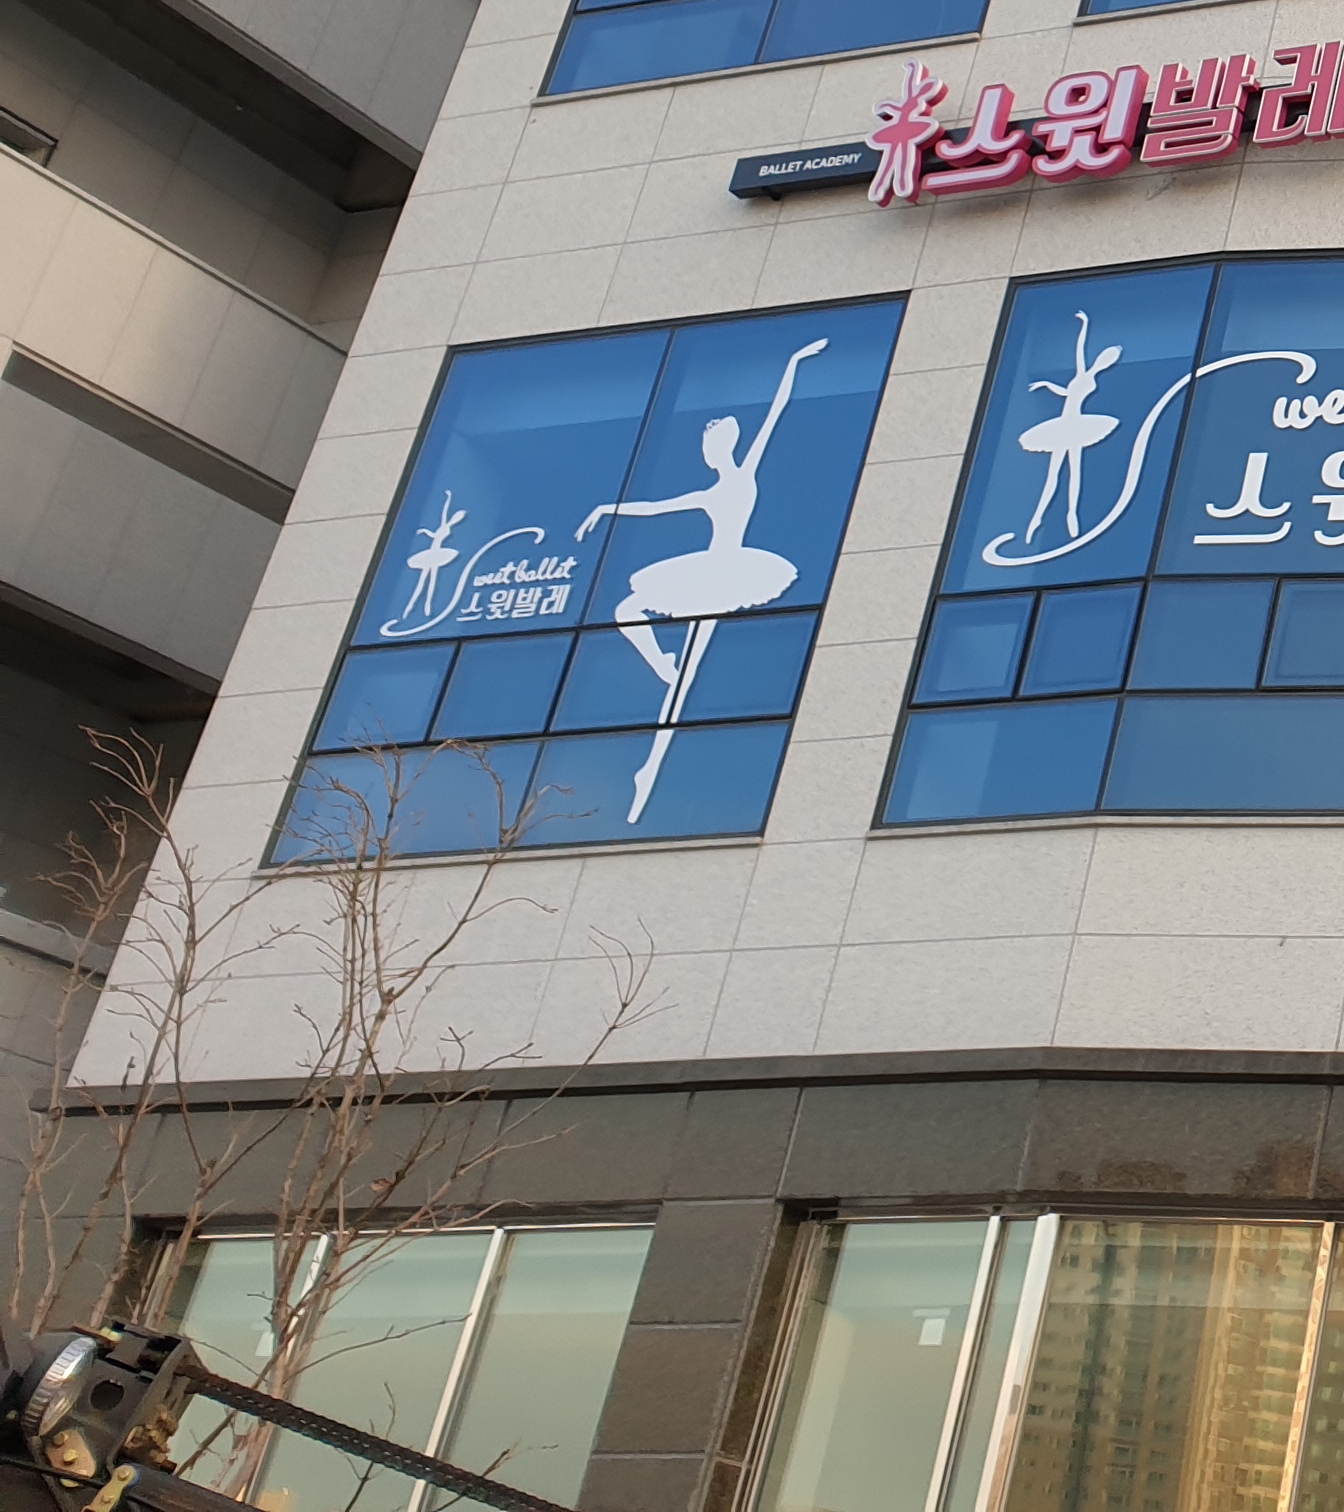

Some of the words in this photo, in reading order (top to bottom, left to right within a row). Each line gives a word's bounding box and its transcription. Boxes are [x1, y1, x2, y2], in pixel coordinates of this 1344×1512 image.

[759, 160, 803, 177] BALLET
[803, 152, 862, 171] ACADEMY
[456, 584, 571, 622] 스윗발레
